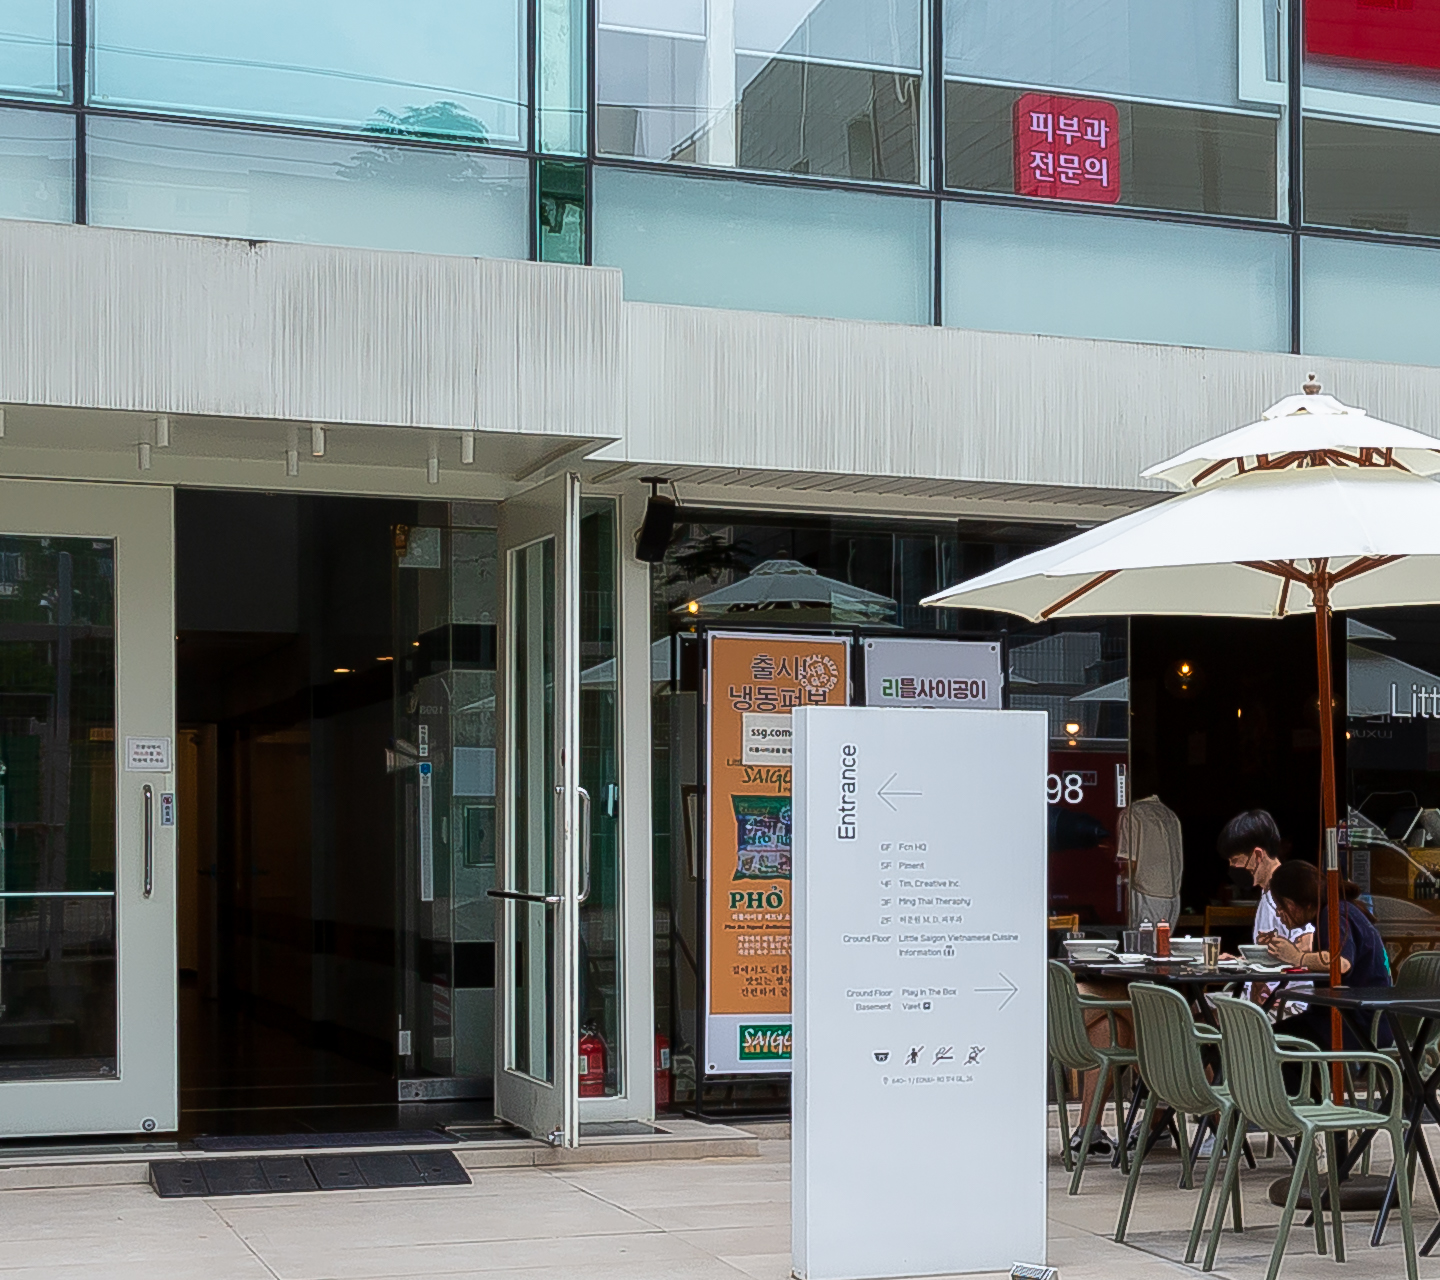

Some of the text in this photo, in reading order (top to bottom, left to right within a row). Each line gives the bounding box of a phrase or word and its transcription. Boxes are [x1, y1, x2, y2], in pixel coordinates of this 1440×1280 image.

[1028, 110, 1110, 151] 피부과
[1028, 150, 1111, 189] 전문의
[882, 677, 987, 700] 리틀사이공이
[837, 743, 857, 841] Entrance
